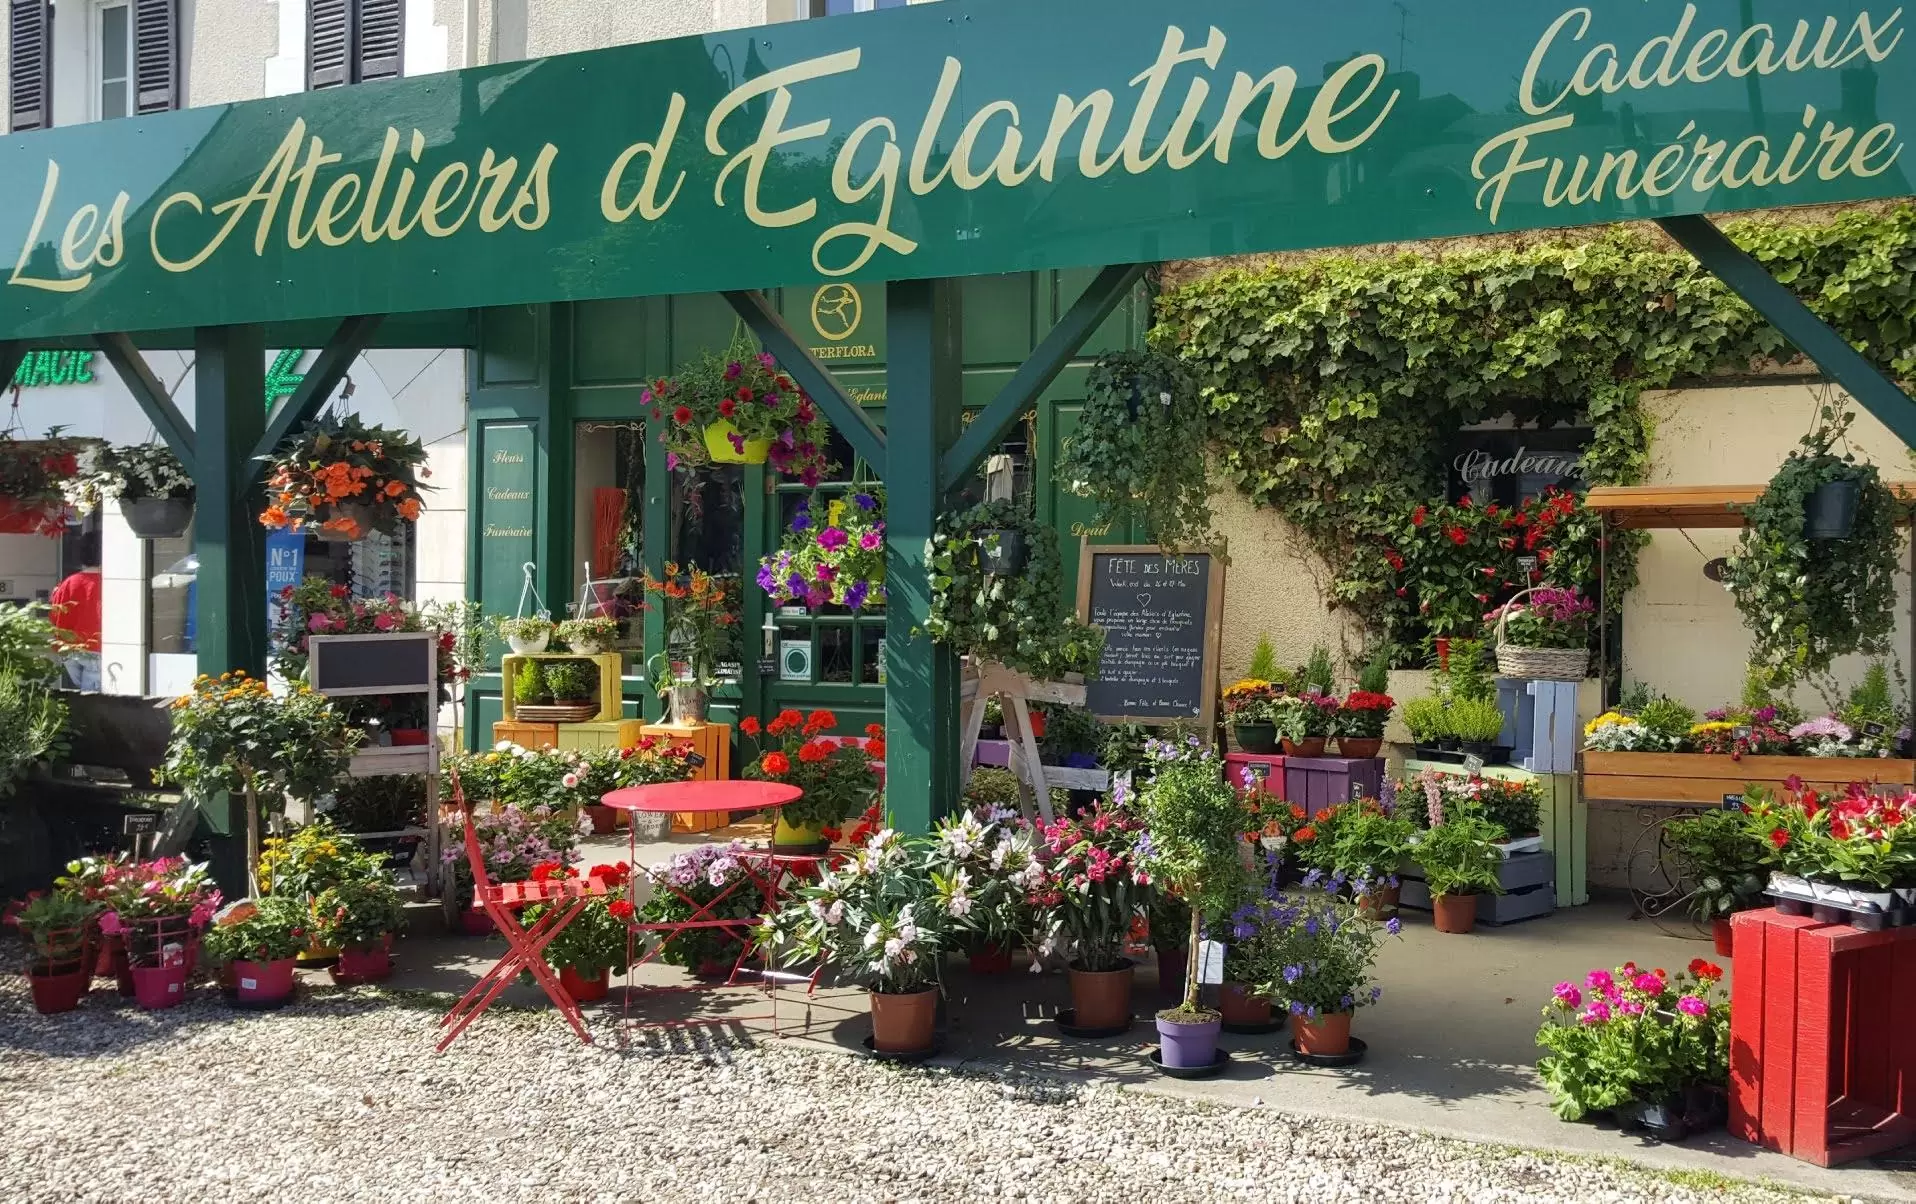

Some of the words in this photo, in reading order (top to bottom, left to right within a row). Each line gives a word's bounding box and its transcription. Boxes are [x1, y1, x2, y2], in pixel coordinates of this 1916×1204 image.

[1518, 3, 1905, 116] Cadeaux
[1470, 104, 1905, 226] Funéraire
[8, 159, 130, 293] Les
[151, 116, 558, 273] Ateliers
[808, 345, 876, 359] TERFLORA
[492, 449, 525, 464] Fleurs
[486, 486, 531, 500] Cadeaux
[483, 523, 533, 537] Funéraire
[1071, 521, 1112, 537] Deuil
[269, 571, 296, 583] POUX
